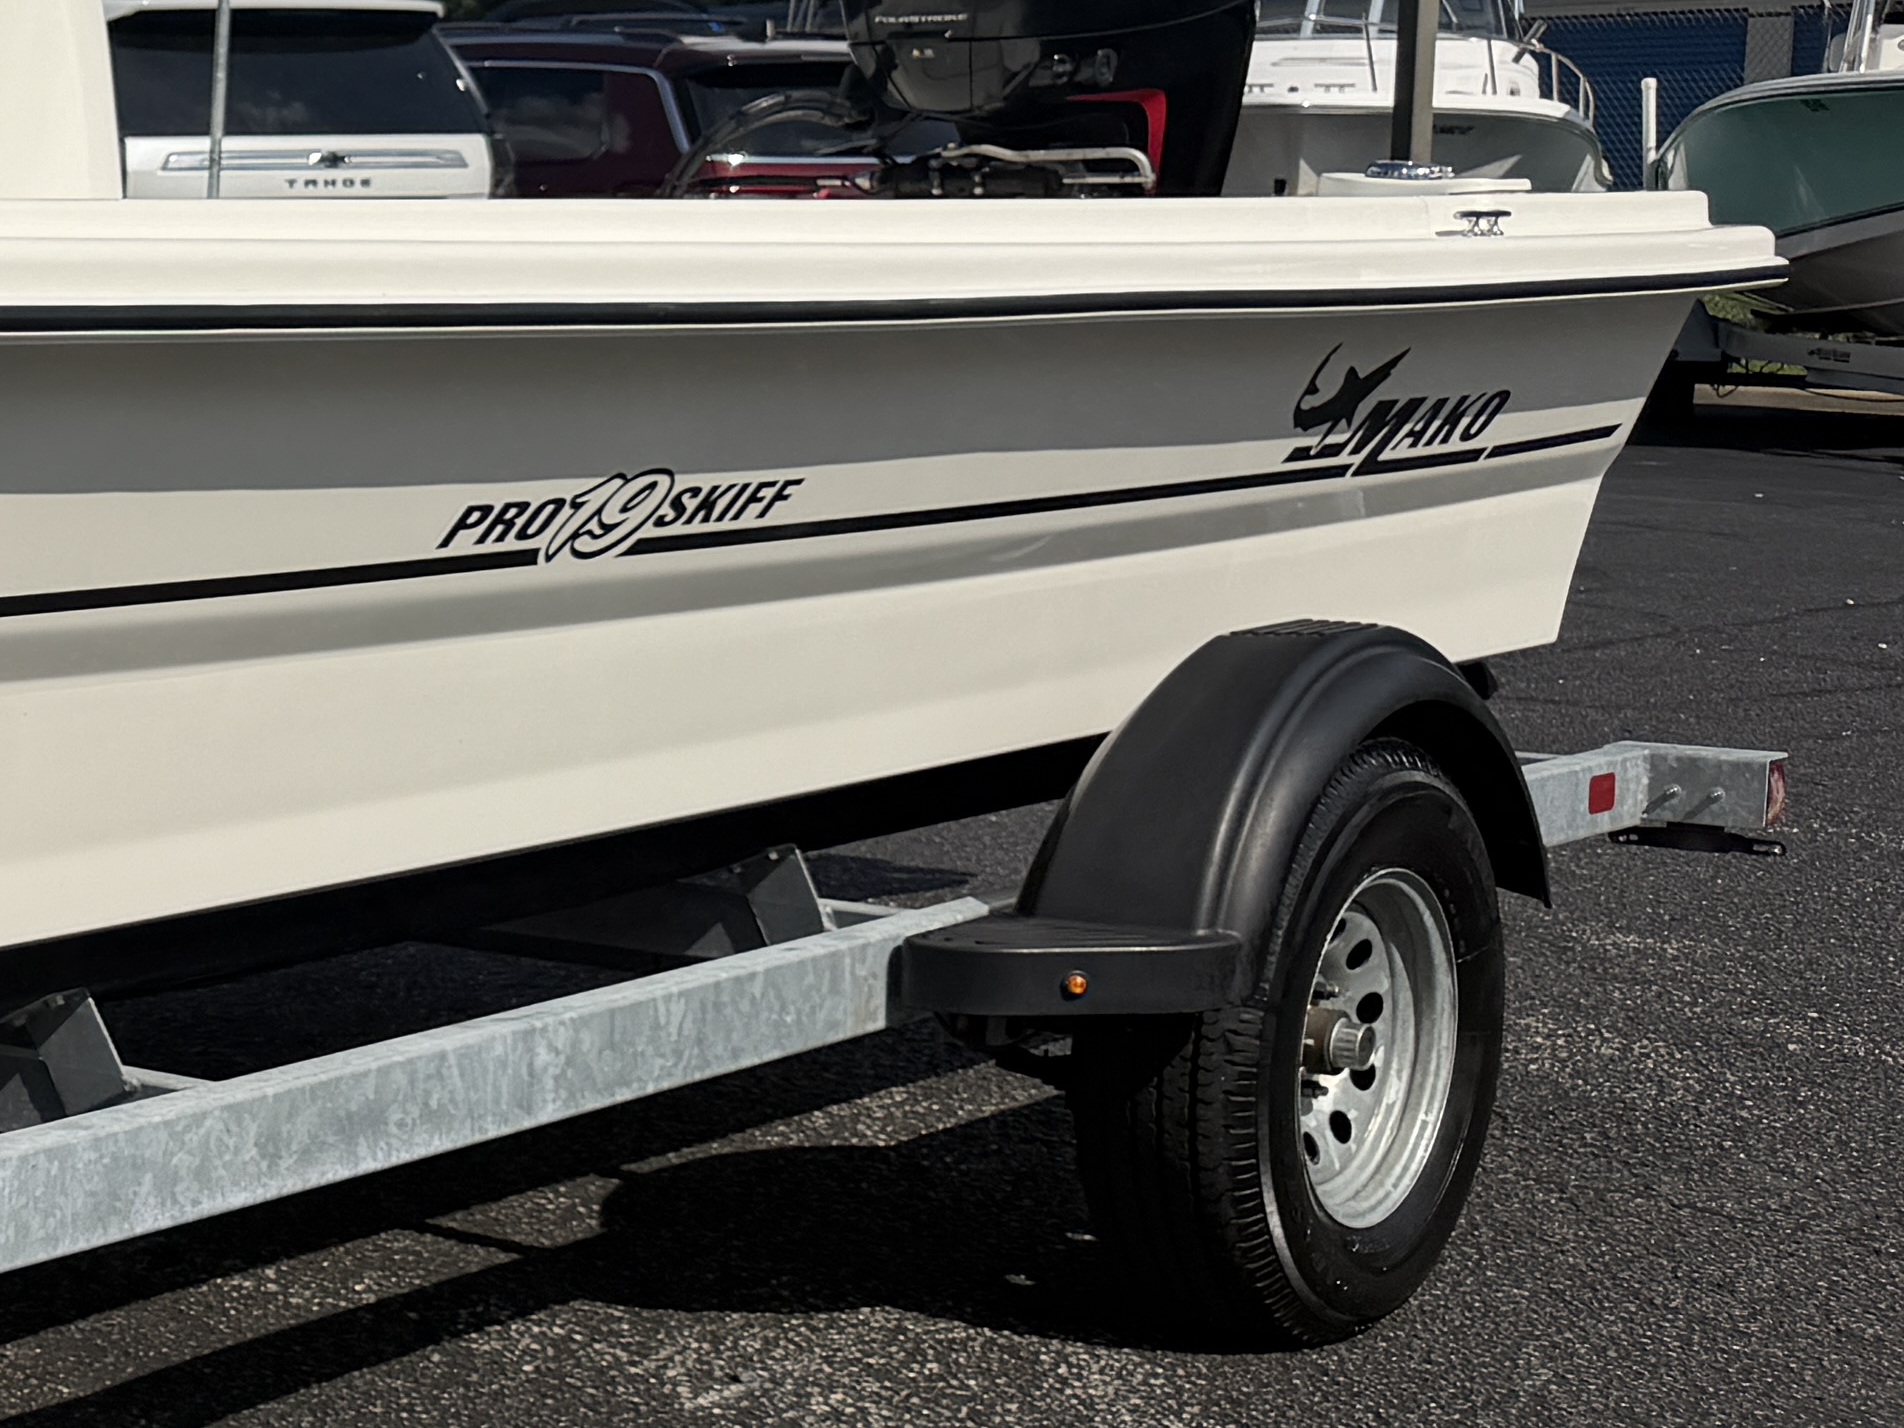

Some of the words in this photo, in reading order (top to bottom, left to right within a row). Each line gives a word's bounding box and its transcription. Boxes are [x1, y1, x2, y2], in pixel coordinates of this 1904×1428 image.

[284, 178, 371, 189] TAHOE
[1281, 389, 1511, 478] MAKO
[435, 498, 567, 550] PRO
[544, 467, 675, 563] 19
[652, 477, 805, 528] SKIFF
